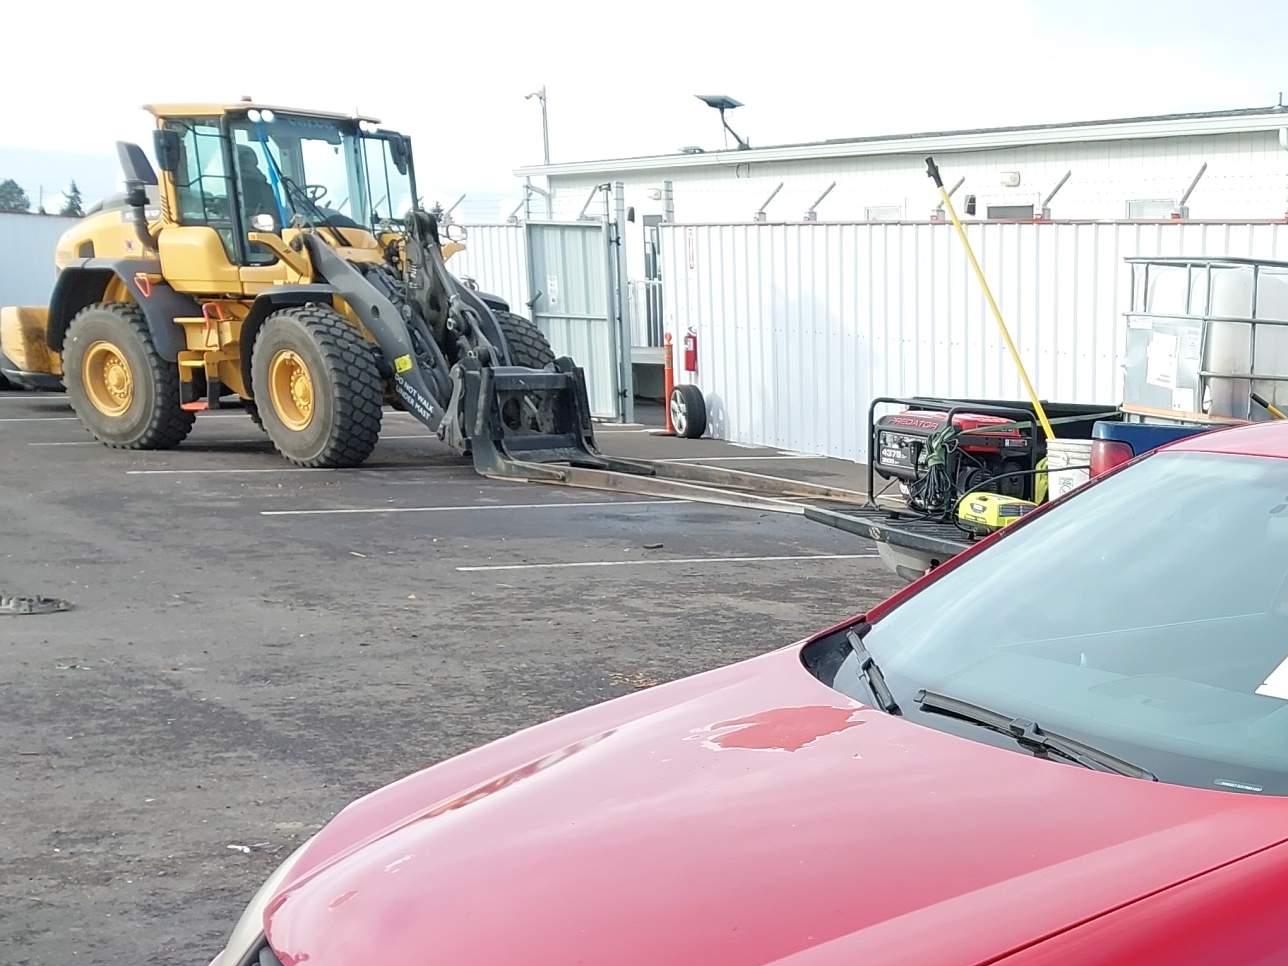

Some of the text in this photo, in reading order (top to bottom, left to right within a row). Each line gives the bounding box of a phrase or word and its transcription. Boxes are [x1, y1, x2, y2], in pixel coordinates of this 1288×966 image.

[395, 373, 434, 414] DO NOT WALK
[395, 384, 431, 420] UNDER MAST
[888, 415, 939, 430] PREDATOR
